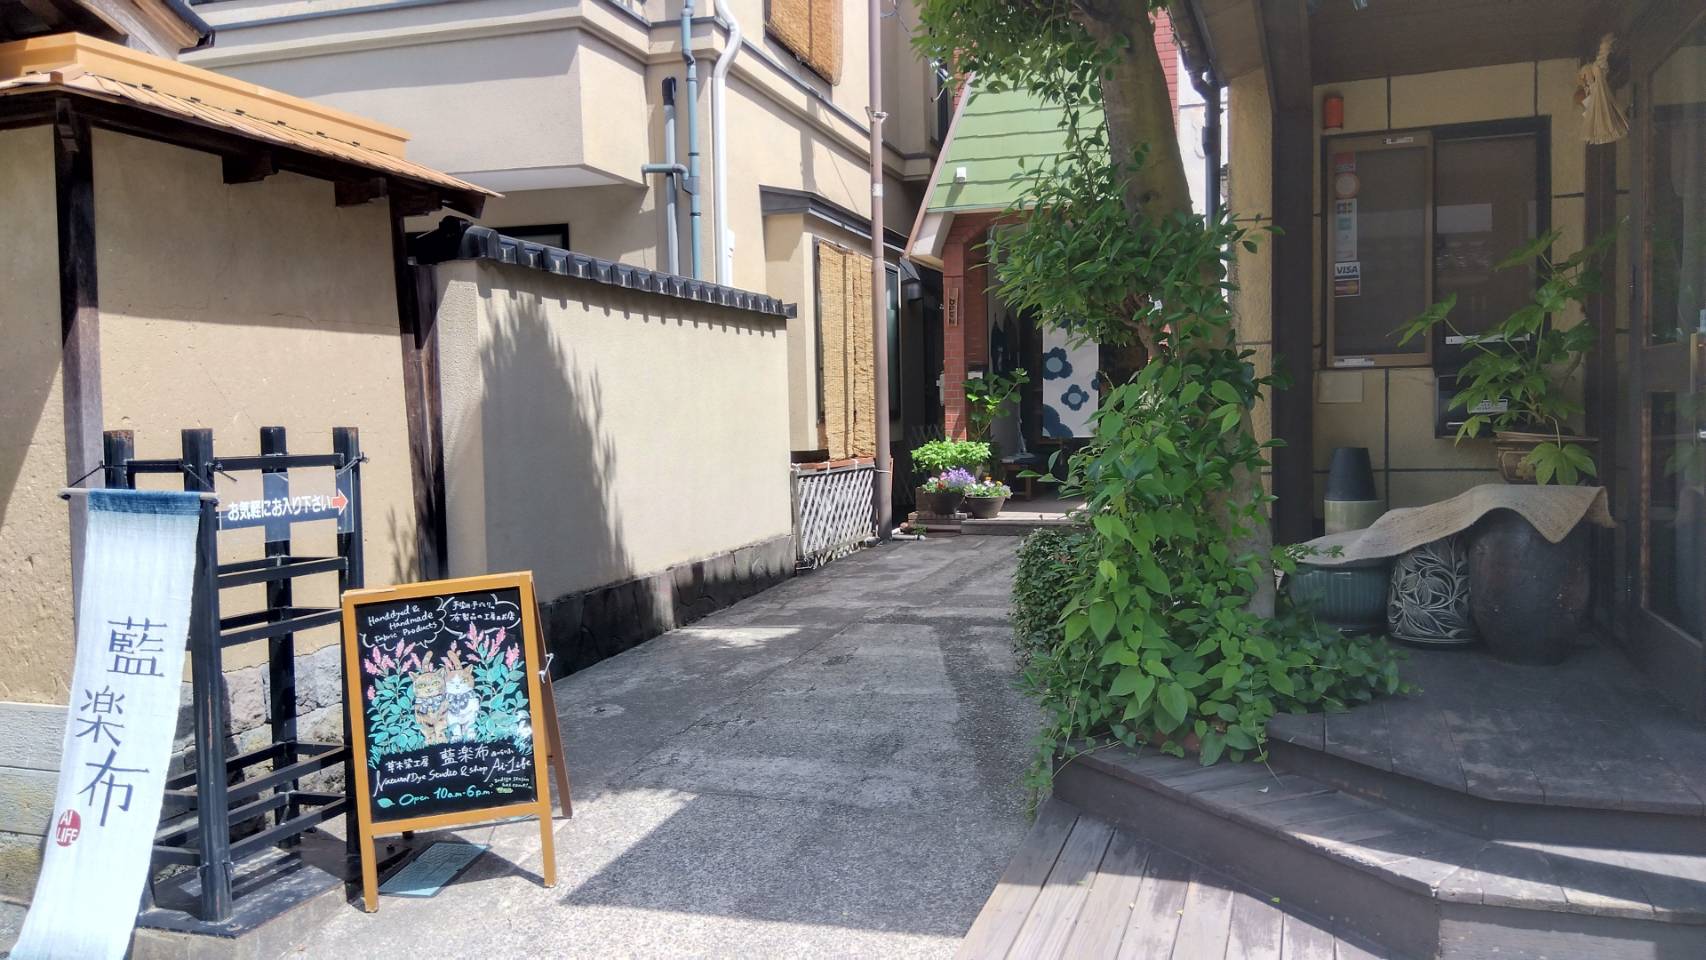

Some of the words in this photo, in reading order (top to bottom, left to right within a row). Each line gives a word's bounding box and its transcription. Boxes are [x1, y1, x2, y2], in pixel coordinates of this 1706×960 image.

[1336, 265, 1358, 274] VISA
[227, 495, 332, 521] お気軽にお入り下さい
[411, 605, 420, 613] &
[389, 610, 434, 631] Handmade
[374, 632, 397, 643] Fabric
[402, 621, 438, 636] Products
[75, 616, 168, 827] 藍楽布
[385, 755, 429, 773] 草木染工房
[440, 744, 489, 766] 藍楽布
[428, 768, 458, 781] Studio
[460, 765, 470, 777] &
[399, 793, 430, 806] Open
[60, 810, 74, 826] AI
[57, 827, 79, 843] LIFE
